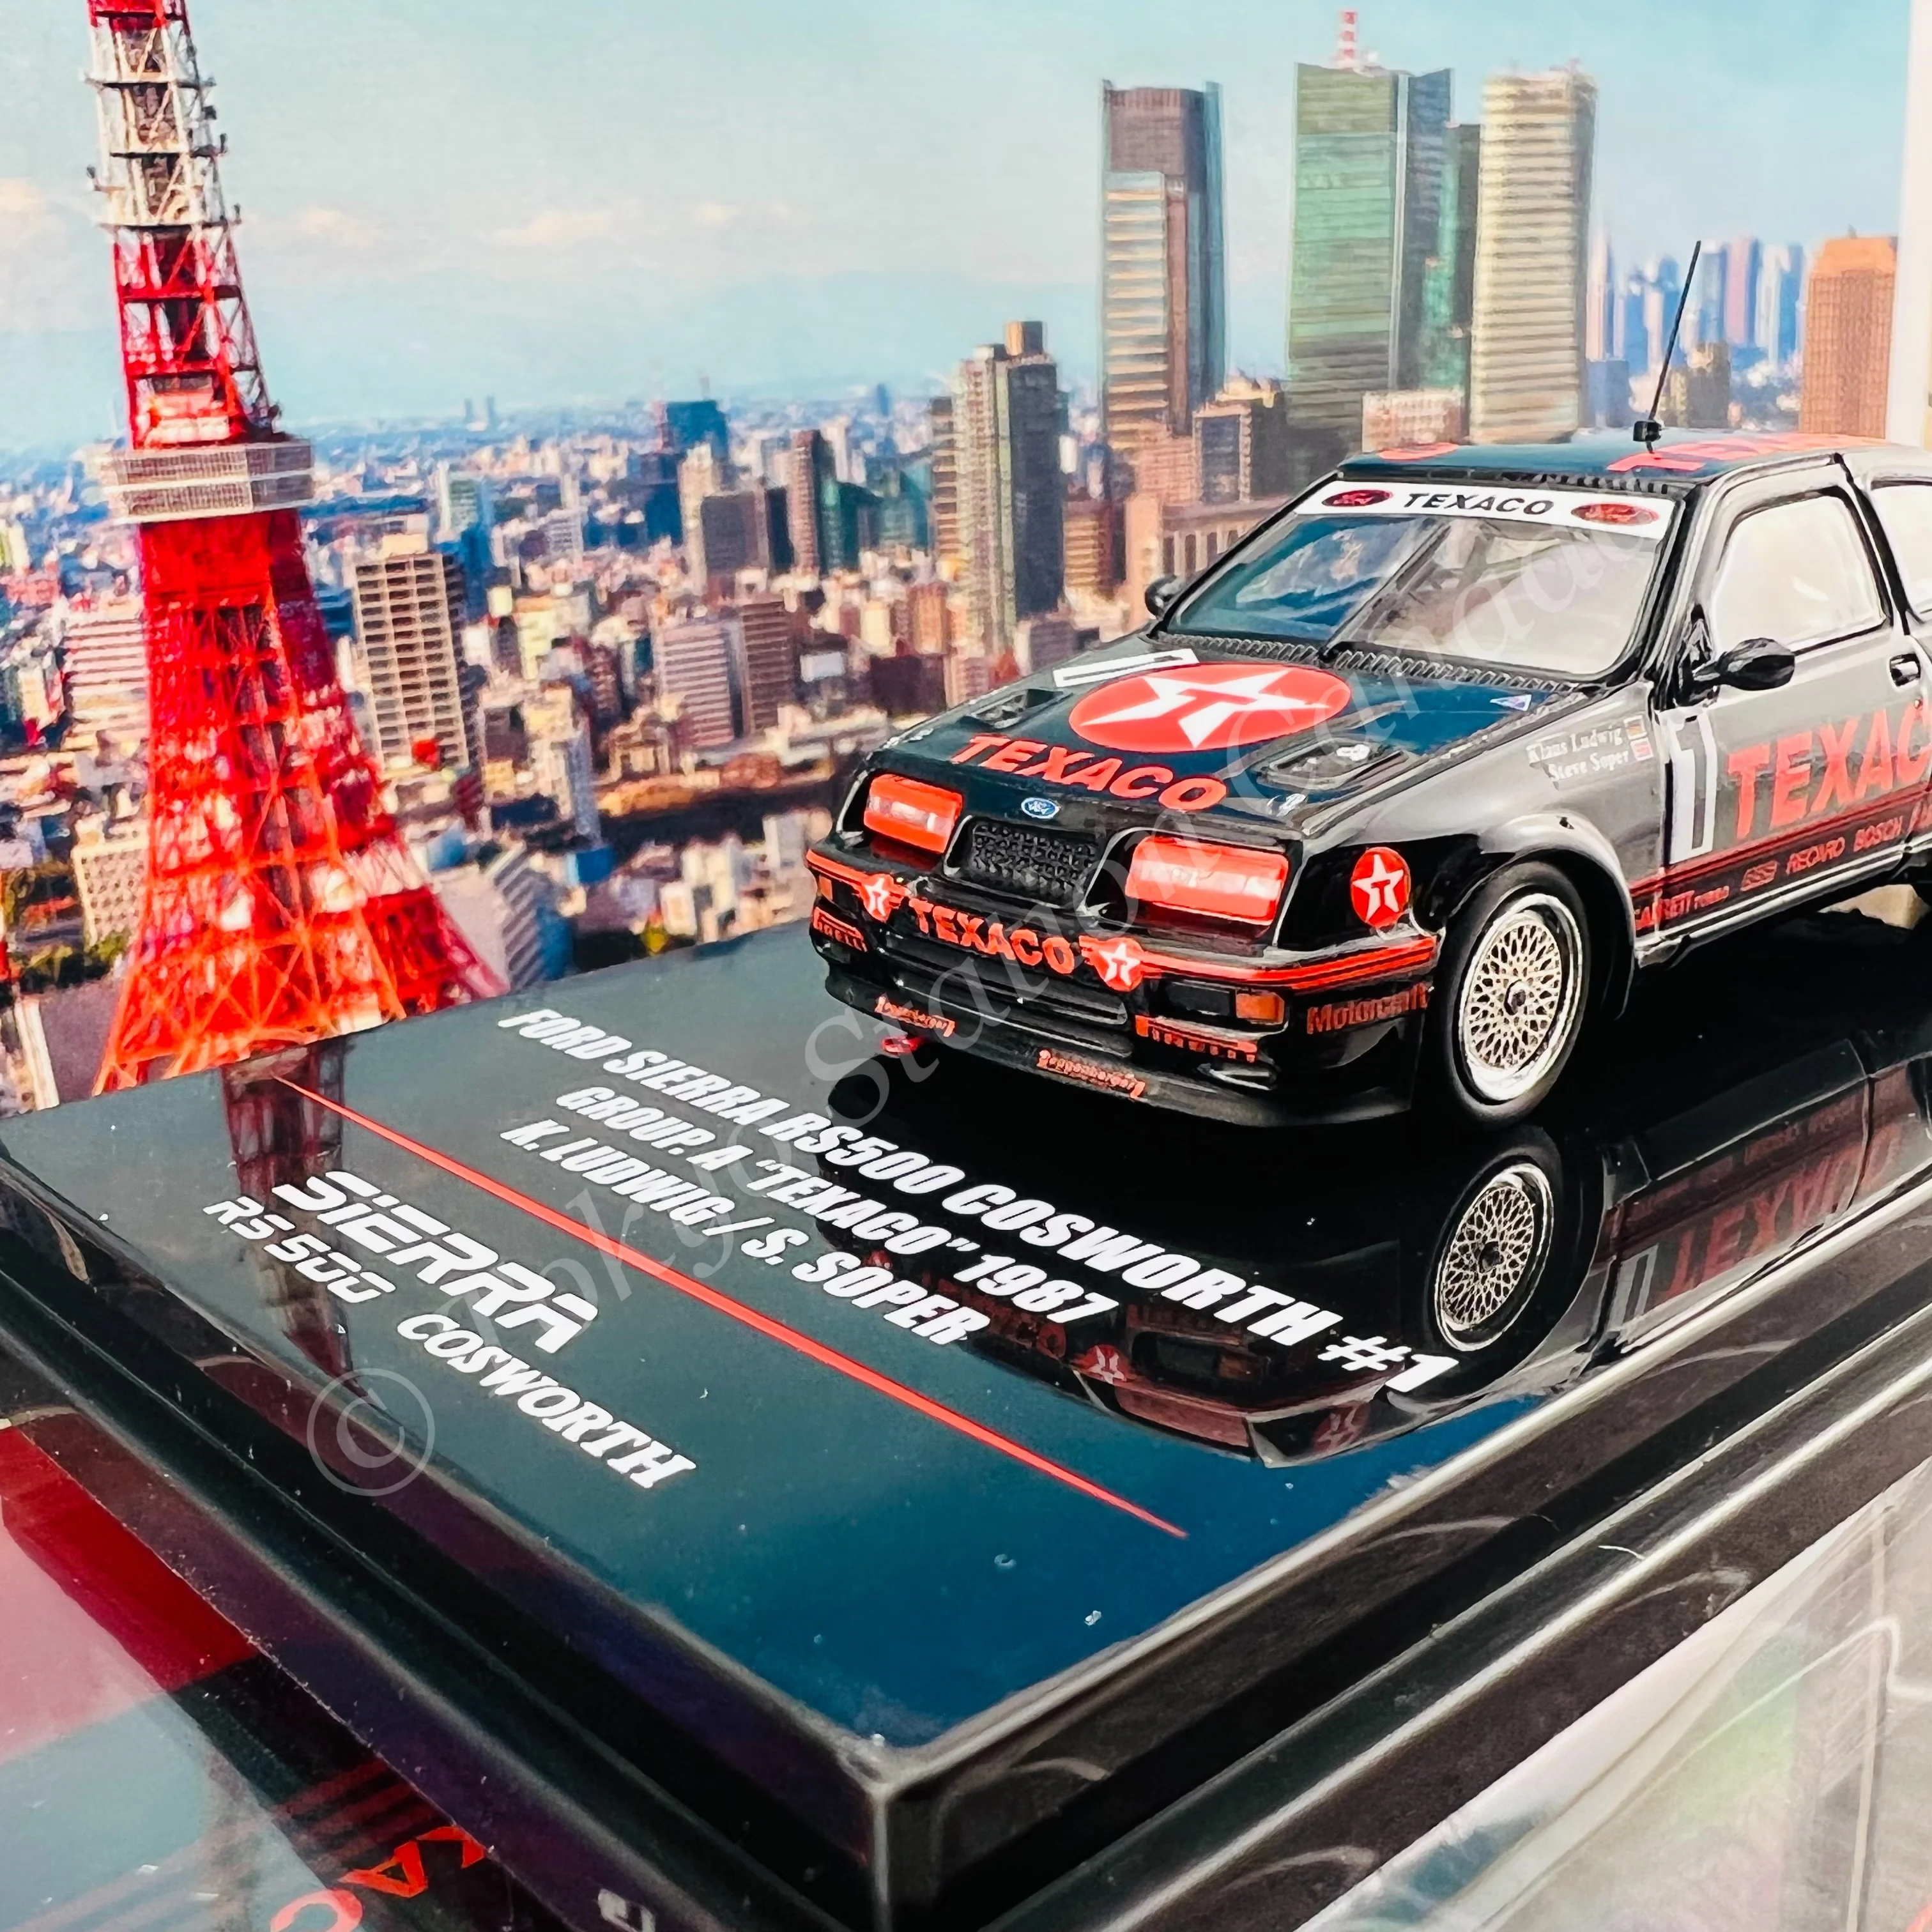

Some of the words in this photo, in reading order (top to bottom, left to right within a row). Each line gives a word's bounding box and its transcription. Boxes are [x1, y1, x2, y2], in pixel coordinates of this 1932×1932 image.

[1404, 492, 1554, 515] TEXACO
[951, 735, 1227, 810] TEXACO
[908, 897, 1075, 974] TEXACO
[498, 1009, 632, 1059] FORD
[603, 1052, 790, 1125] SIERRA
[758, 1113, 965, 1193] RS500
[942, 1185, 1343, 1345] COSWORTH
[686, 1145, 753, 1170] A
[954, 1255, 1119, 1322] 1987
[272, 1172, 598, 1353] SIERRA
[792, 1252, 990, 1344] SOPER
[397, 1314, 696, 1488] COSWORTH
